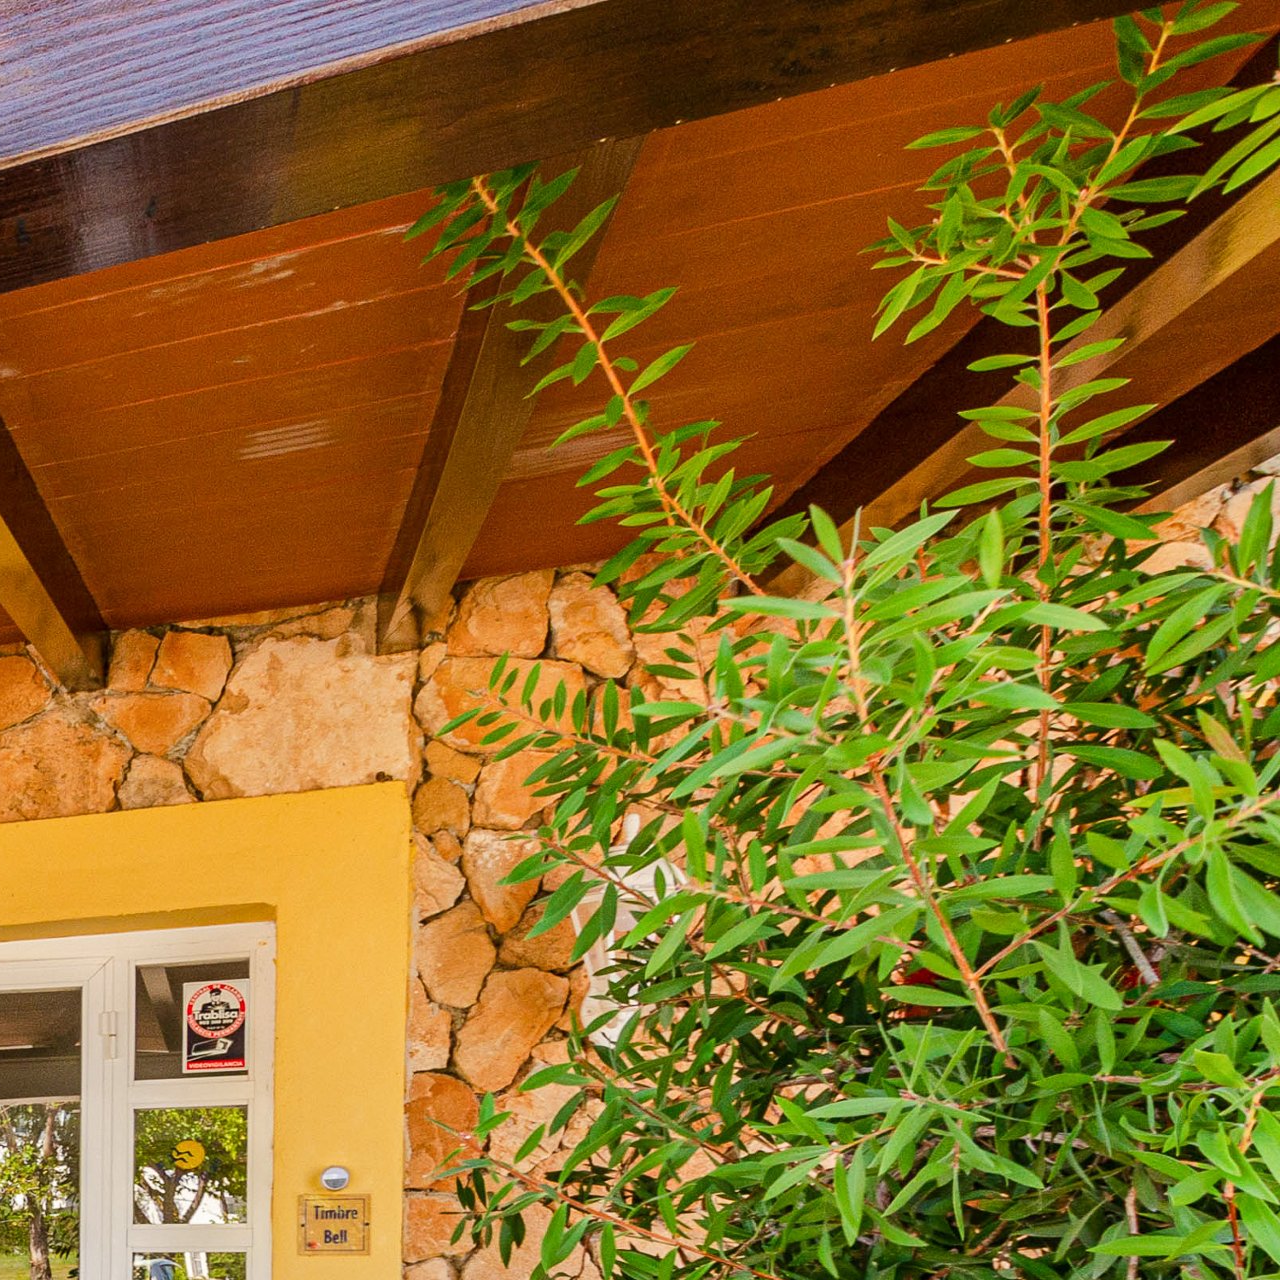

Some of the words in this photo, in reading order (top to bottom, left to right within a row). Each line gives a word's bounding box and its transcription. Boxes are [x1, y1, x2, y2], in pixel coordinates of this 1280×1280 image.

[193, 1009, 238, 1020] Trablisa
[313, 1205, 358, 1220] Timbre
[324, 1229, 347, 1244] Bell
